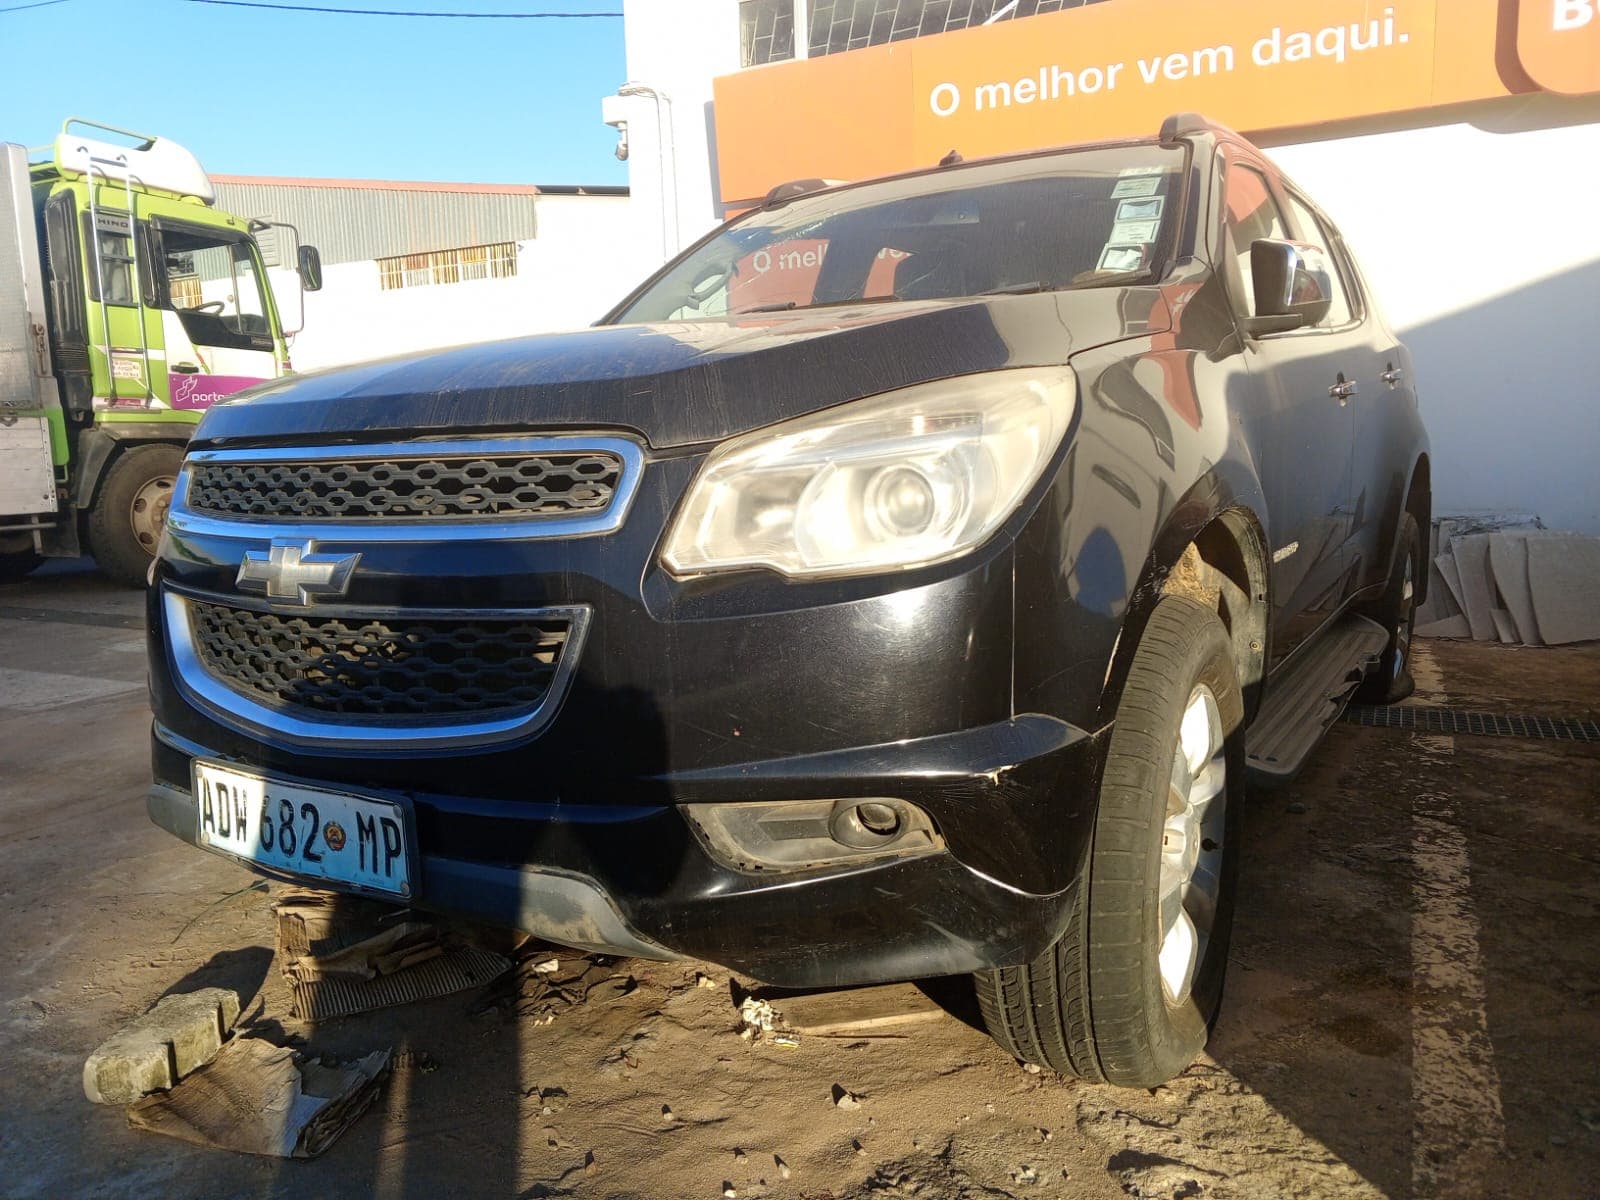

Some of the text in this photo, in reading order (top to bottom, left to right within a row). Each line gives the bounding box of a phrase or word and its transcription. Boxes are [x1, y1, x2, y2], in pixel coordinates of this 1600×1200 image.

[1553, 0, 1600, 31] B
[929, 7, 1409, 117] O melhor vem daqui.
[97, 217, 130, 228] HINO
[202, 776, 402, 878] ADW 682 MP
